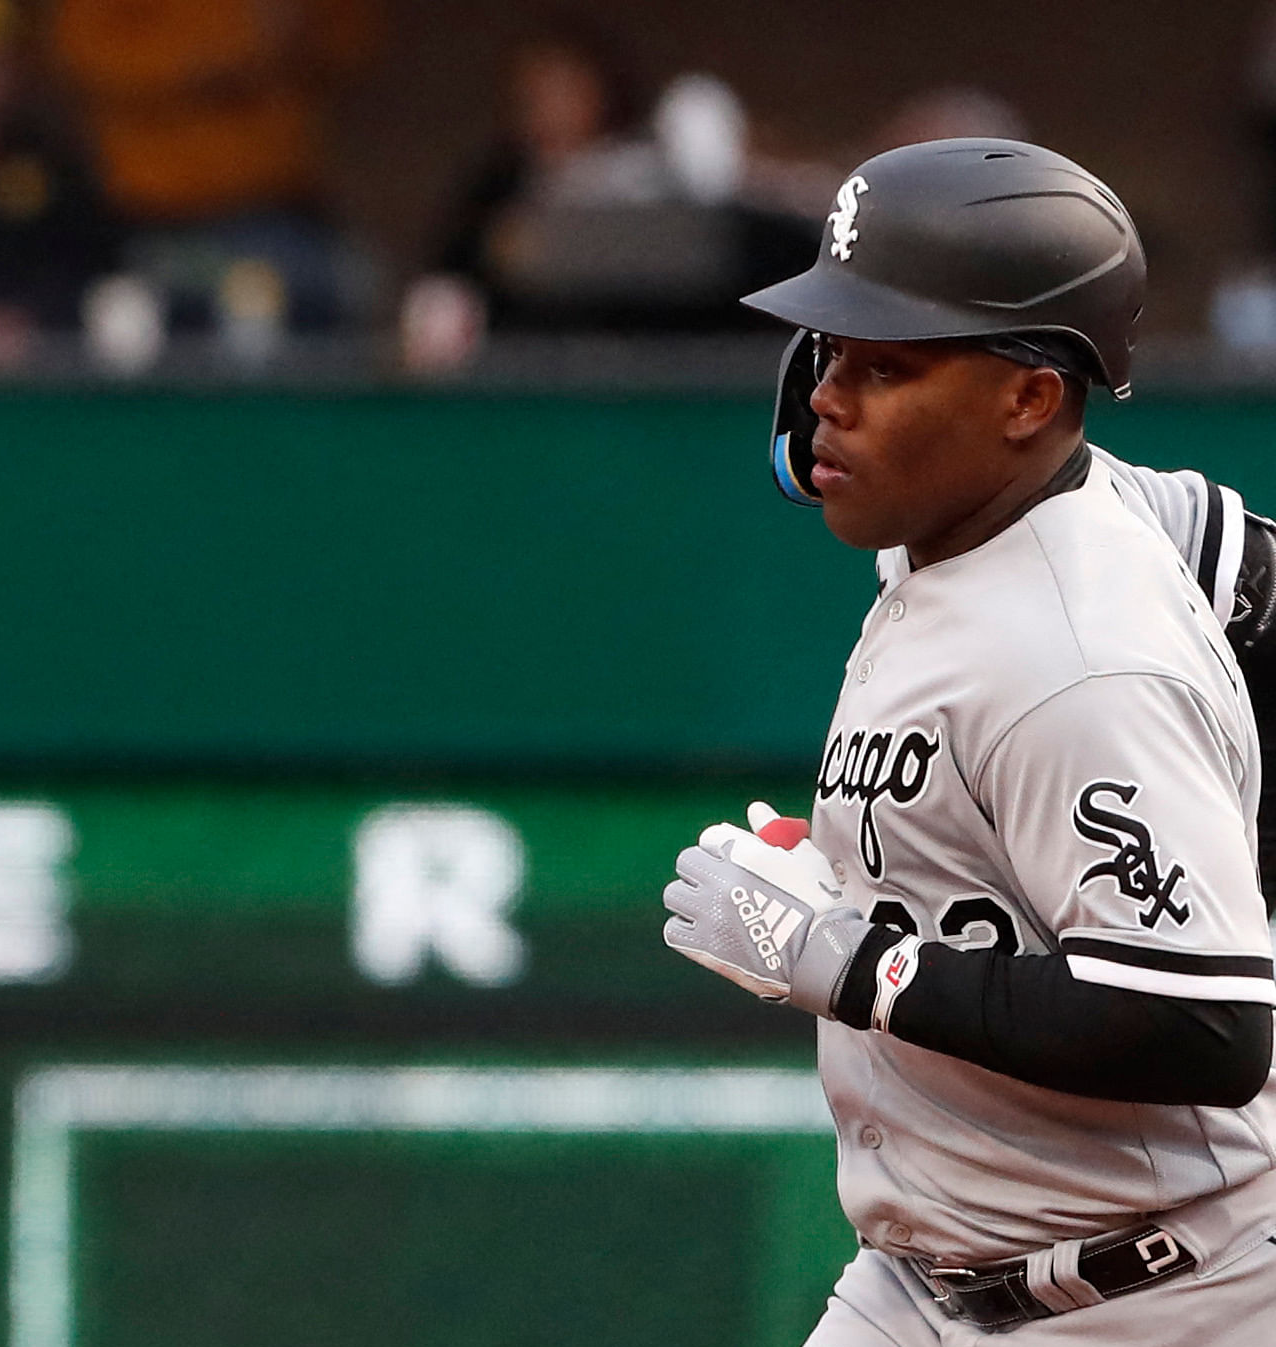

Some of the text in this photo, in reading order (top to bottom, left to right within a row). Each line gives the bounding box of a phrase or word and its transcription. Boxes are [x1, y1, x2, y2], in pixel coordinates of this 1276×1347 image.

[817, 726, 943, 883] cago
[1072, 777, 1193, 932] Sox
[729, 886, 782, 971] adidas
